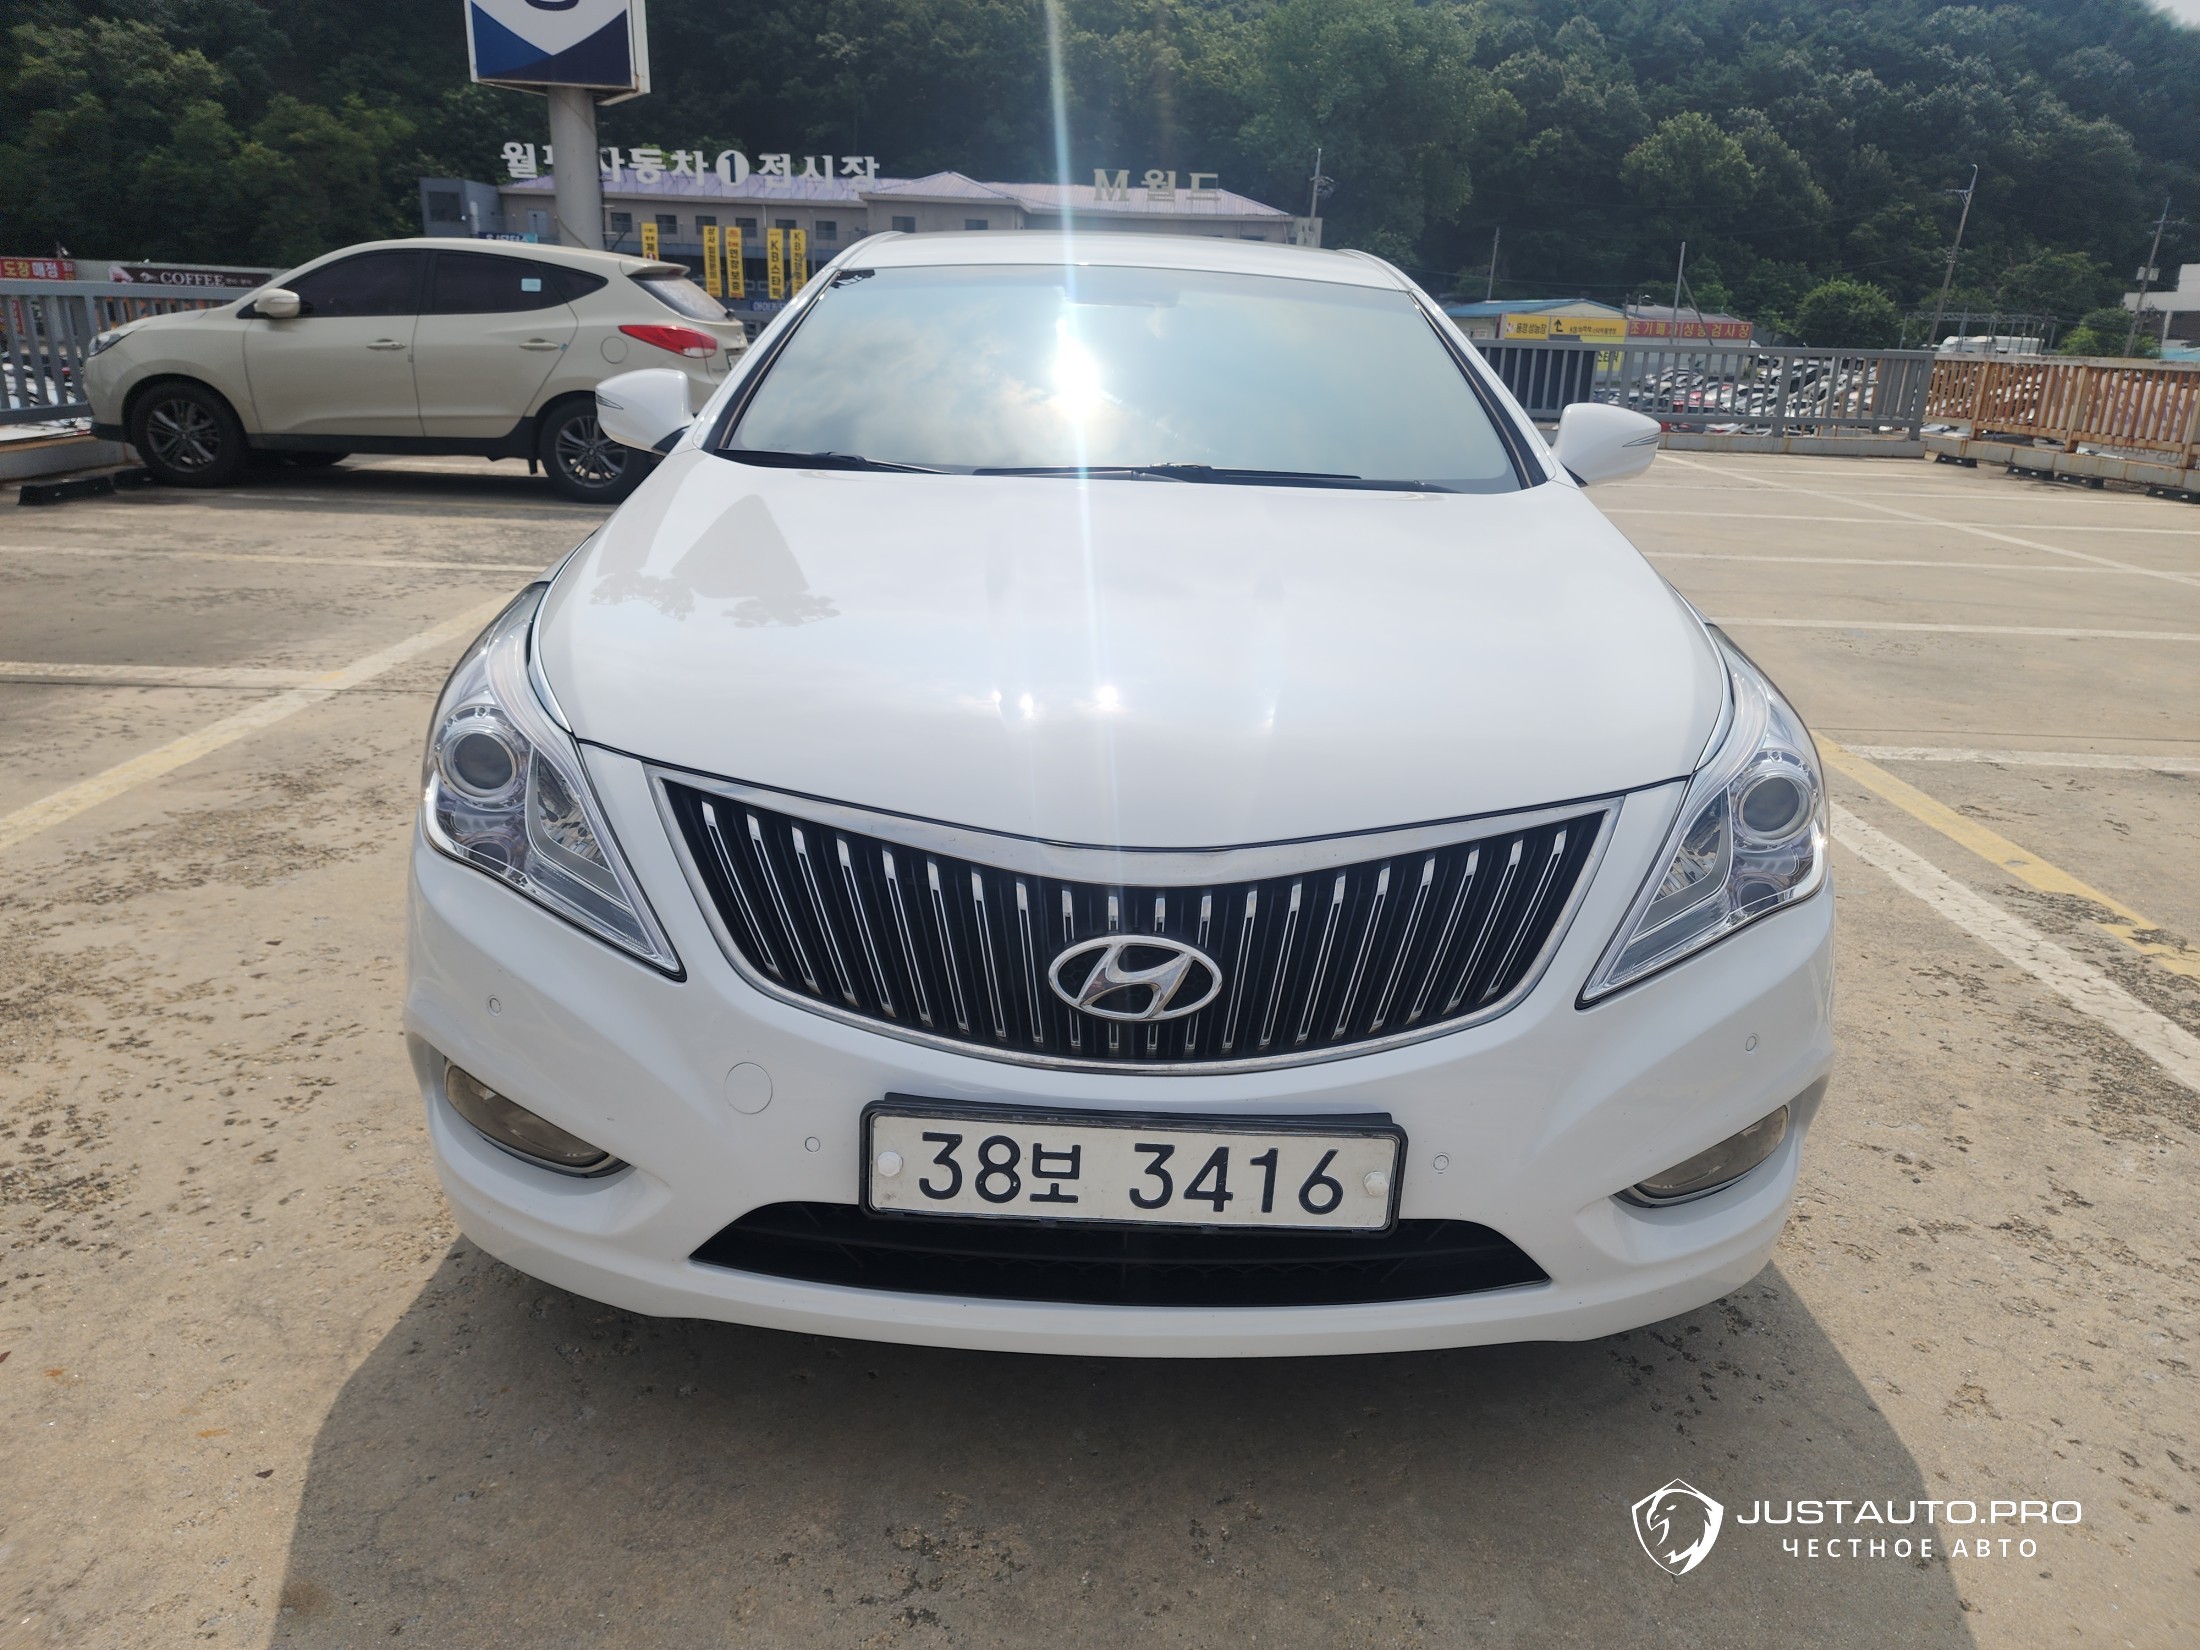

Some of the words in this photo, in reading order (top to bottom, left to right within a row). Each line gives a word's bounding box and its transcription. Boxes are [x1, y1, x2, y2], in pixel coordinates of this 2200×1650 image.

[757, 153, 880, 192] 전시장
[159, 272, 226, 287] COFFEE
[918, 1130, 1082, 1204] 38보
[1127, 1141, 1345, 1216] 3416
